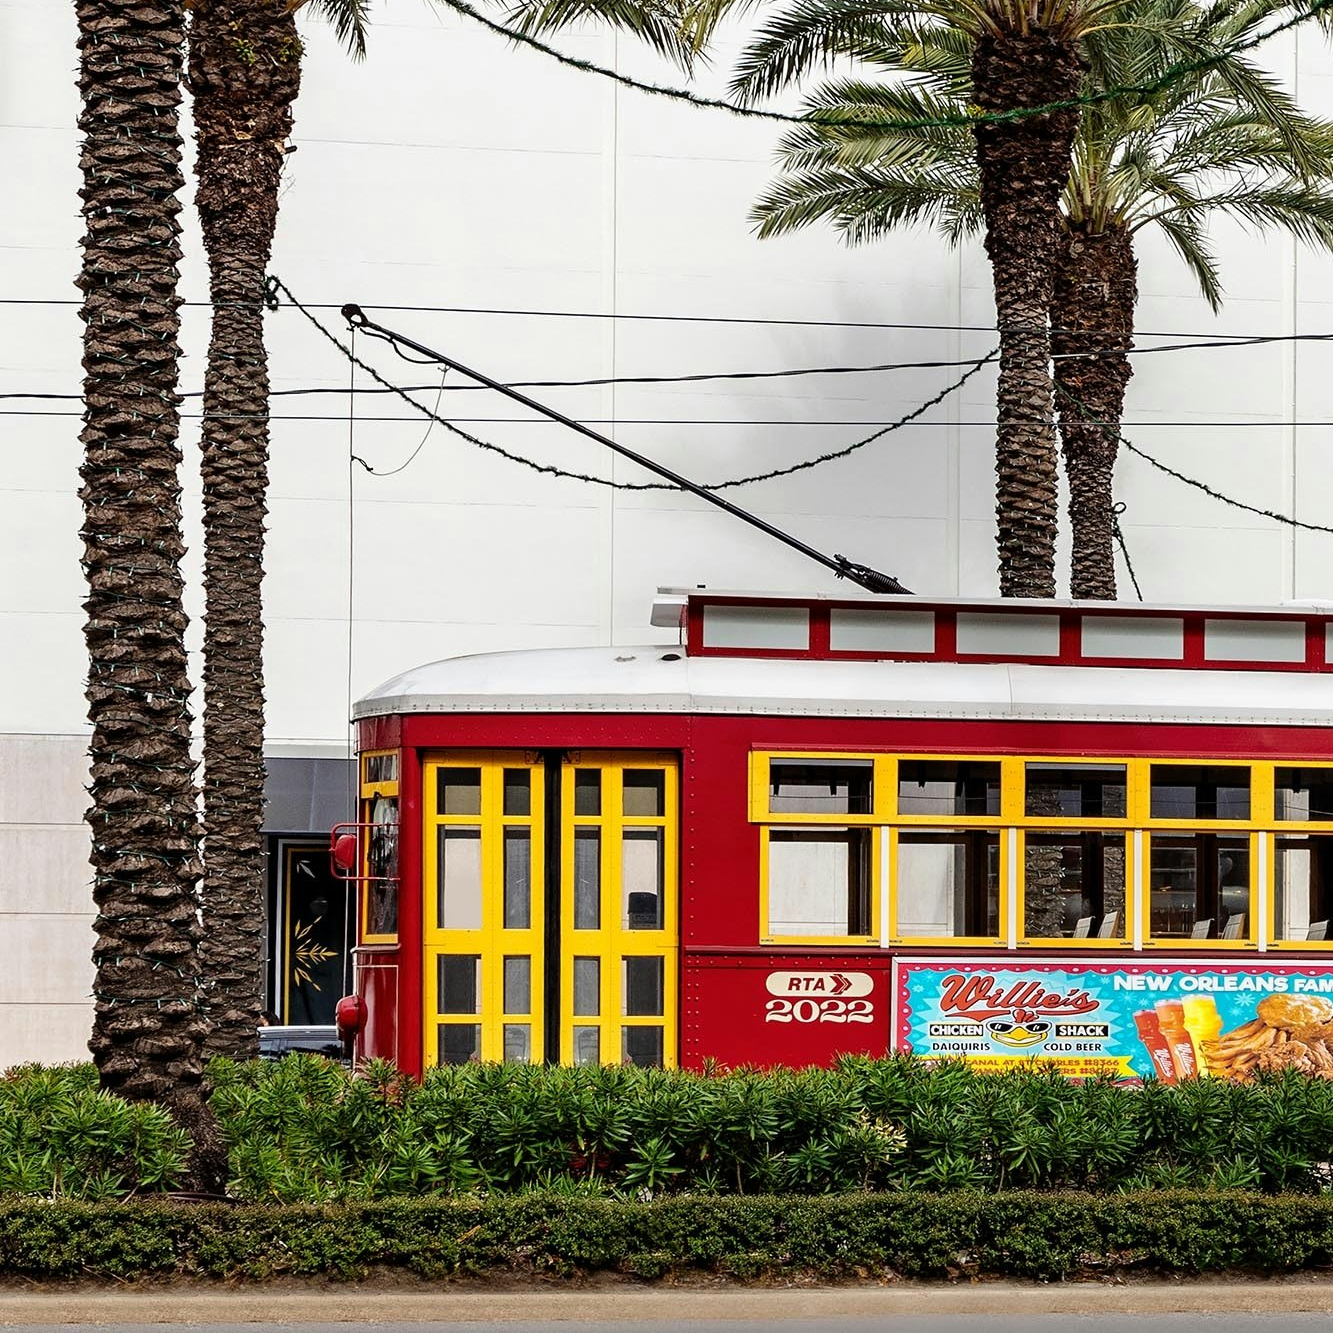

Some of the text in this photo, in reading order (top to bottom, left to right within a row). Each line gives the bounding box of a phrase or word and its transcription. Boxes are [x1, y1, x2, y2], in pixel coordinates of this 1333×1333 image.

[788, 977, 826, 991] RTA
[1114, 975, 1173, 991] NEW
[1179, 976, 1289, 992] ORLEANS
[940, 975, 1100, 1012] Willie's
[765, 999, 874, 1023] 2022
[930, 1025, 983, 1036] CHICKEN
[1059, 1025, 1105, 1036] SHACK
[932, 1042, 990, 1051] DAIQUIRIS
[1044, 1043, 1102, 1051] COLD BEER
